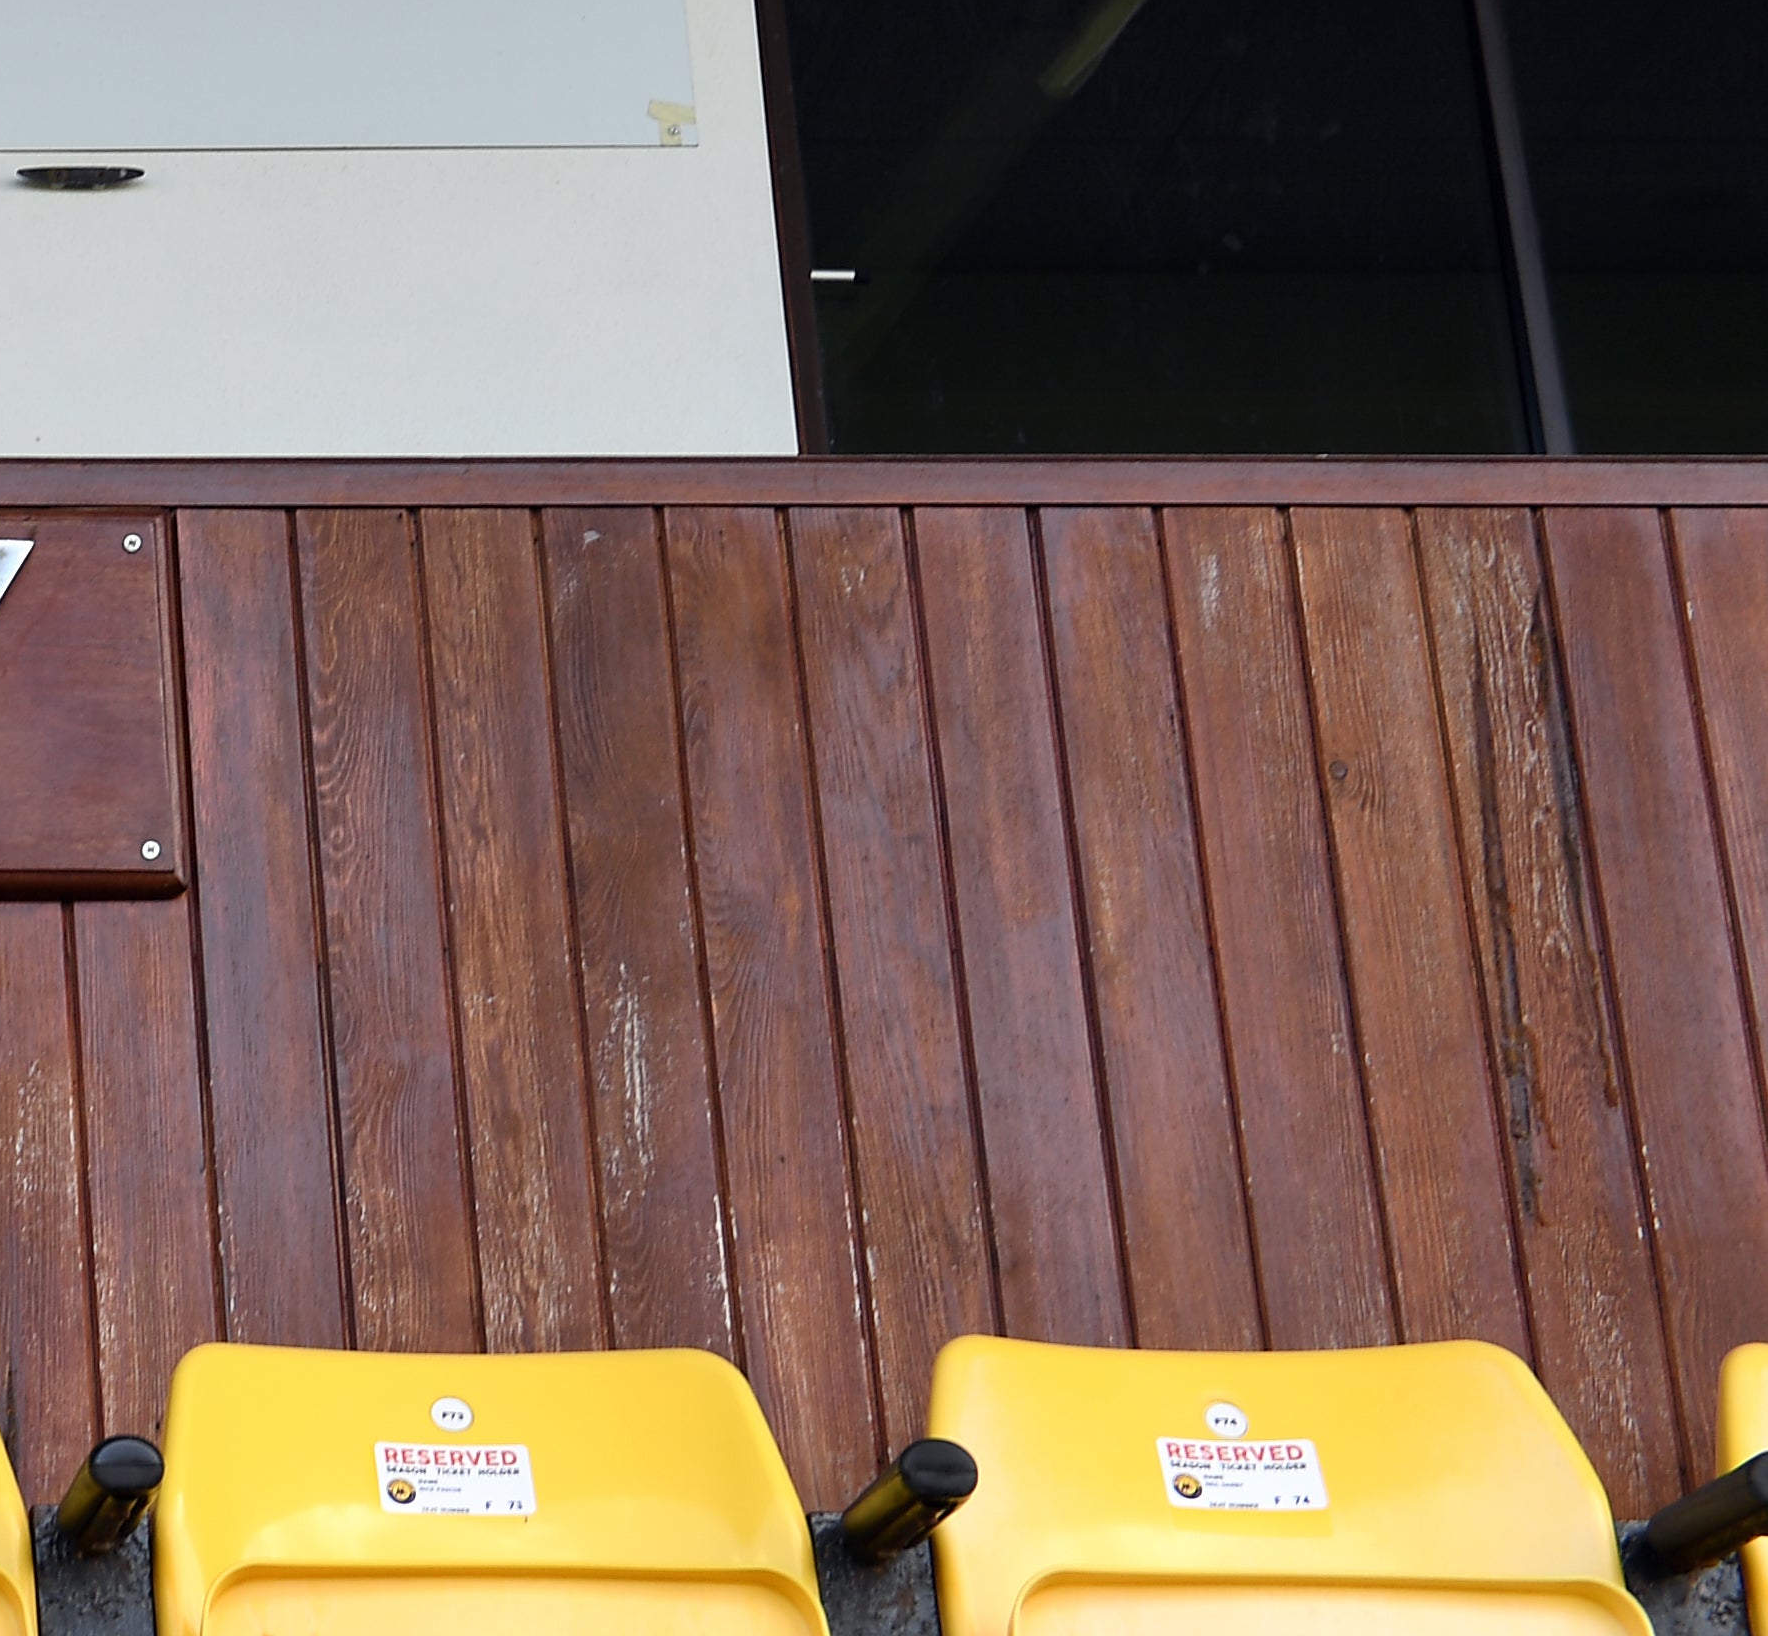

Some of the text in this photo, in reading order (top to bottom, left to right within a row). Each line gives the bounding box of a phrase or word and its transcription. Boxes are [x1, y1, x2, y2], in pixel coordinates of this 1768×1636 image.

[384, 1447, 517, 1466] RESERVED
[1166, 1442, 1303, 1461] RESERVED
[387, 1465, 427, 1475] SEASON
[437, 1467, 470, 1475] TICKET
[1171, 1460, 1210, 1469] SEASON
